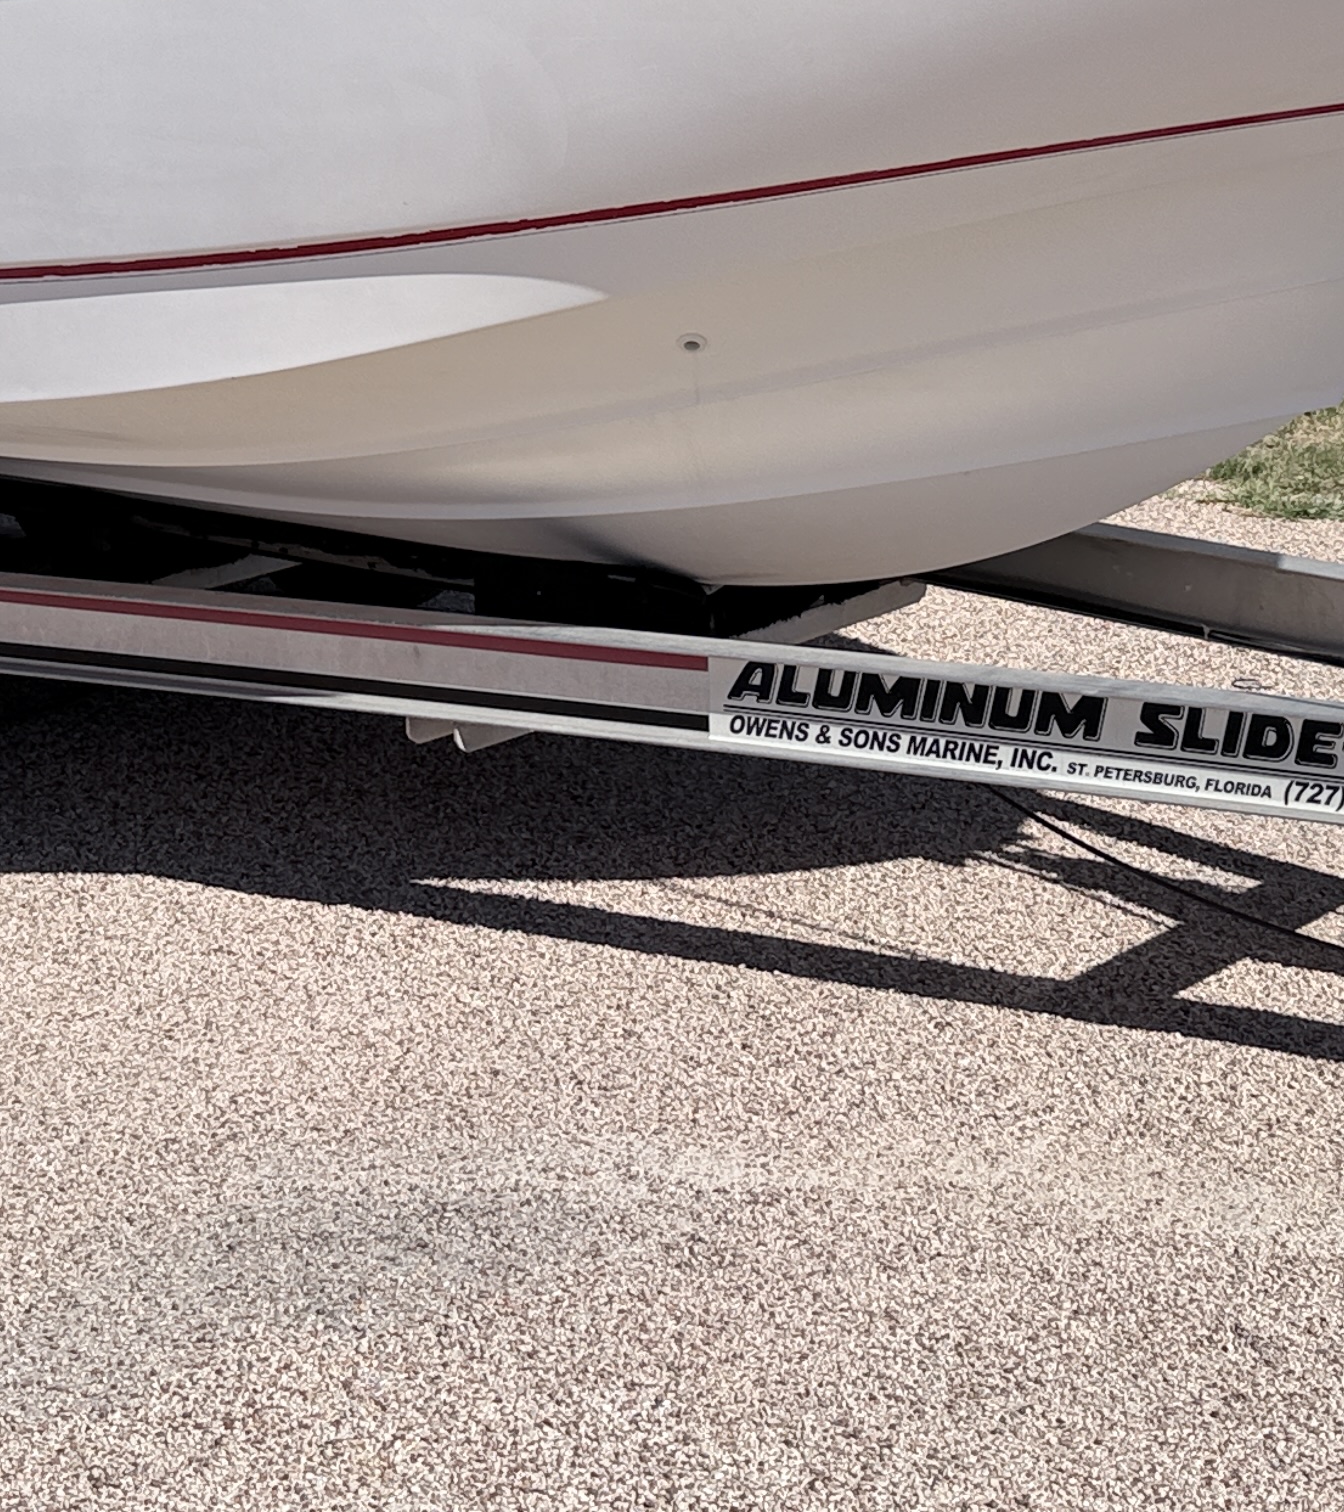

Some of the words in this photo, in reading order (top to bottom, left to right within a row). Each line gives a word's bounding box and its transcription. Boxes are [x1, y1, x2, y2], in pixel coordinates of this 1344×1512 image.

[727, 660, 1109, 742] ALUMINUM
[730, 714, 810, 743] OWENS
[815, 724, 832, 744] &
[838, 726, 902, 753] SONS
[906, 735, 1003, 770] MARINE,
[1010, 748, 1058, 772] INC.
[1066, 761, 1091, 778] ST.
[1093, 765, 1201, 792] PETERSBURG,
[1204, 777, 1272, 800] FLORIDA
